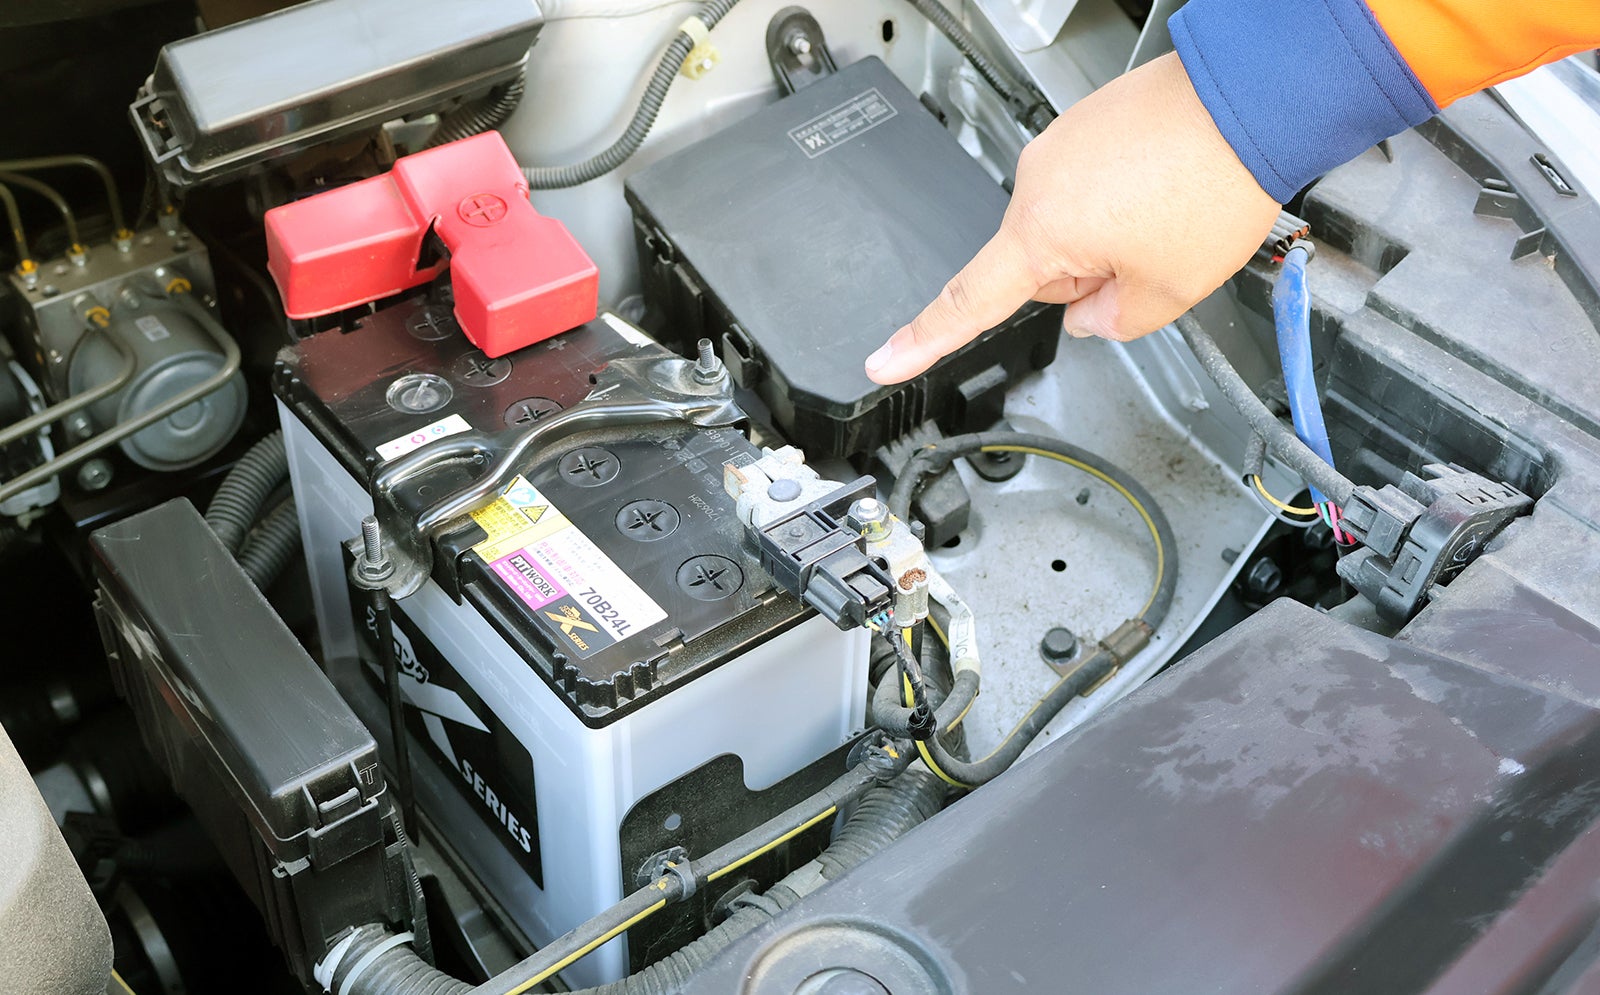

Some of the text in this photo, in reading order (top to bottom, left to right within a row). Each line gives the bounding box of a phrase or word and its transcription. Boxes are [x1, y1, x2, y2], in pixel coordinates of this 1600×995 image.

[804, 133, 826, 150] X4
[579, 586, 632, 637] 70B24L
[568, 632, 590, 651] SERIES
[462, 758, 532, 854] SERIES
